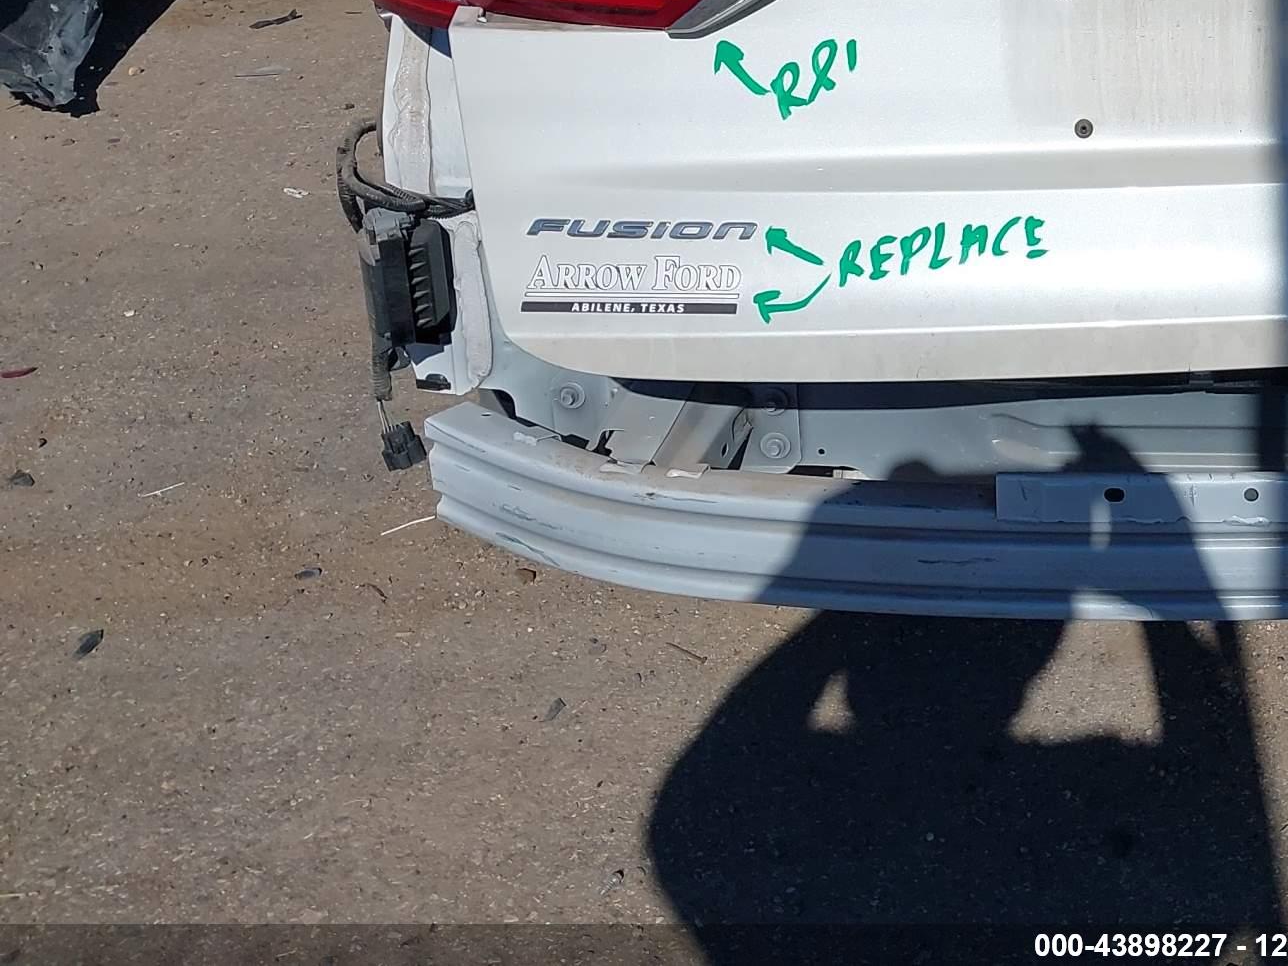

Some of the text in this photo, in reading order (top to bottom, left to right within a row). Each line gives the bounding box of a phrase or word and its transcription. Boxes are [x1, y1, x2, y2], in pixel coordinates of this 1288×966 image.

[526, 218, 758, 240] FUSION
[839, 215, 1049, 288] REPLACE
[526, 254, 742, 290] ARROW FORD
[571, 302, 685, 313] ABILENE, TEXAS
